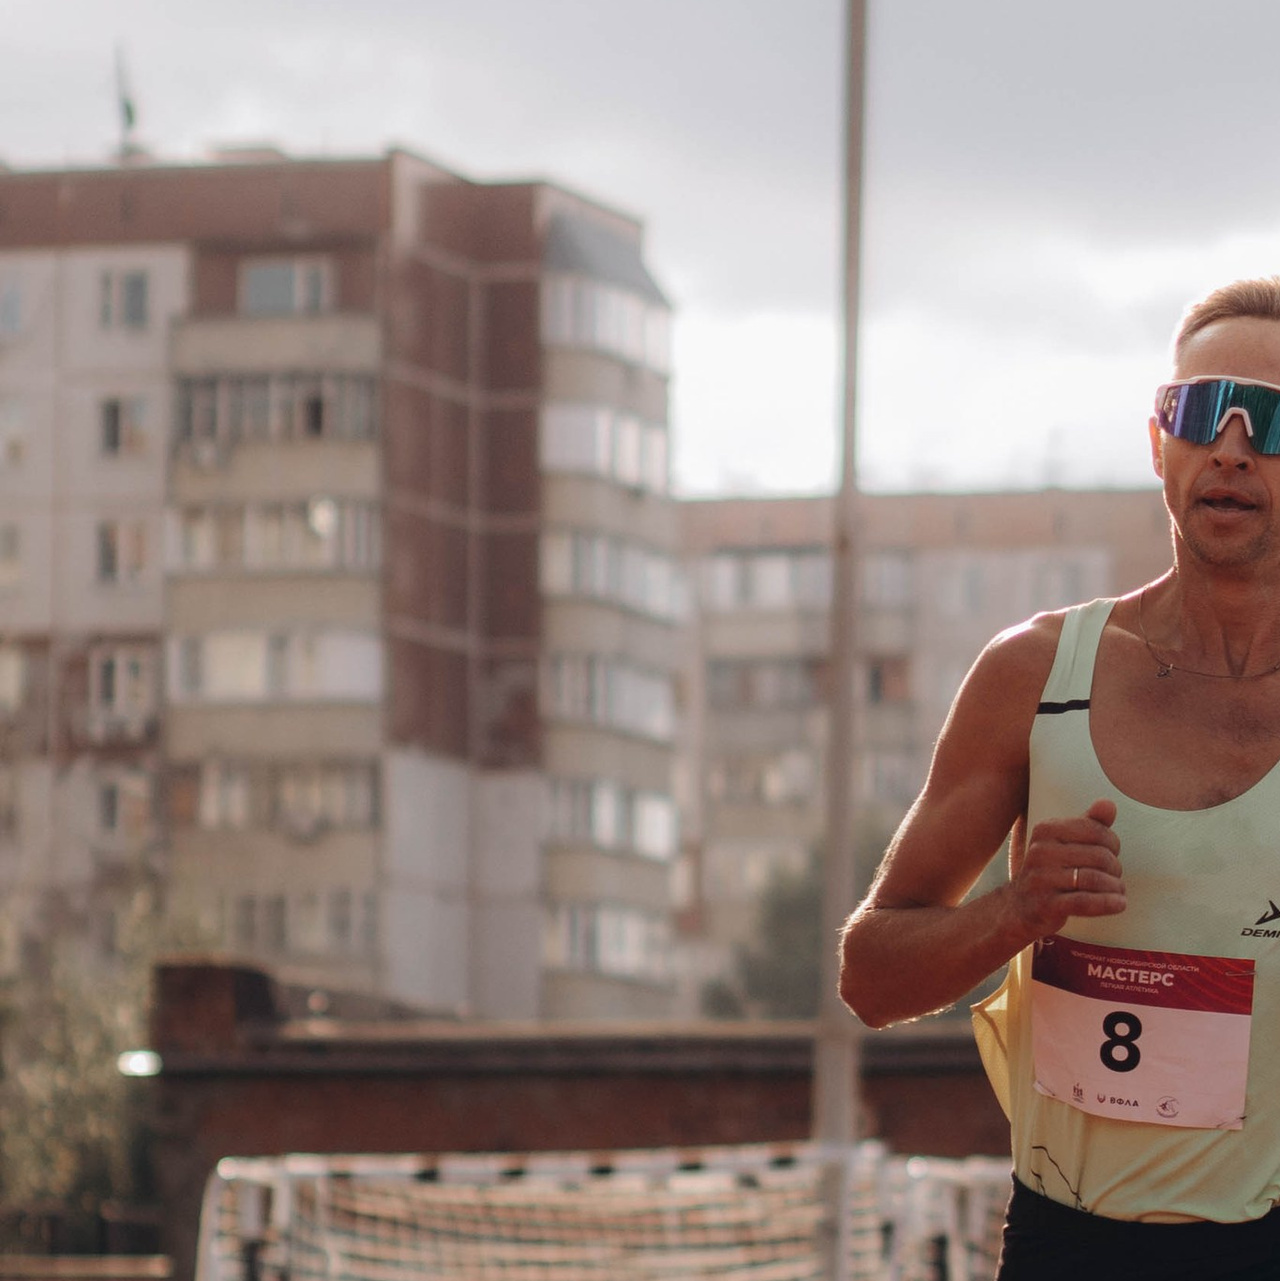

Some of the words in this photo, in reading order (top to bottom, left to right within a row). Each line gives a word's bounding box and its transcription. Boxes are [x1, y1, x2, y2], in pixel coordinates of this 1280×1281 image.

[1087, 963, 1175, 987] МАСТЕРС
[1167, 963, 1200, 972] ОБЛАСТИ
[1100, 1010, 1142, 1072] 8
[1109, 1096, 1140, 1107] ВФЛА
